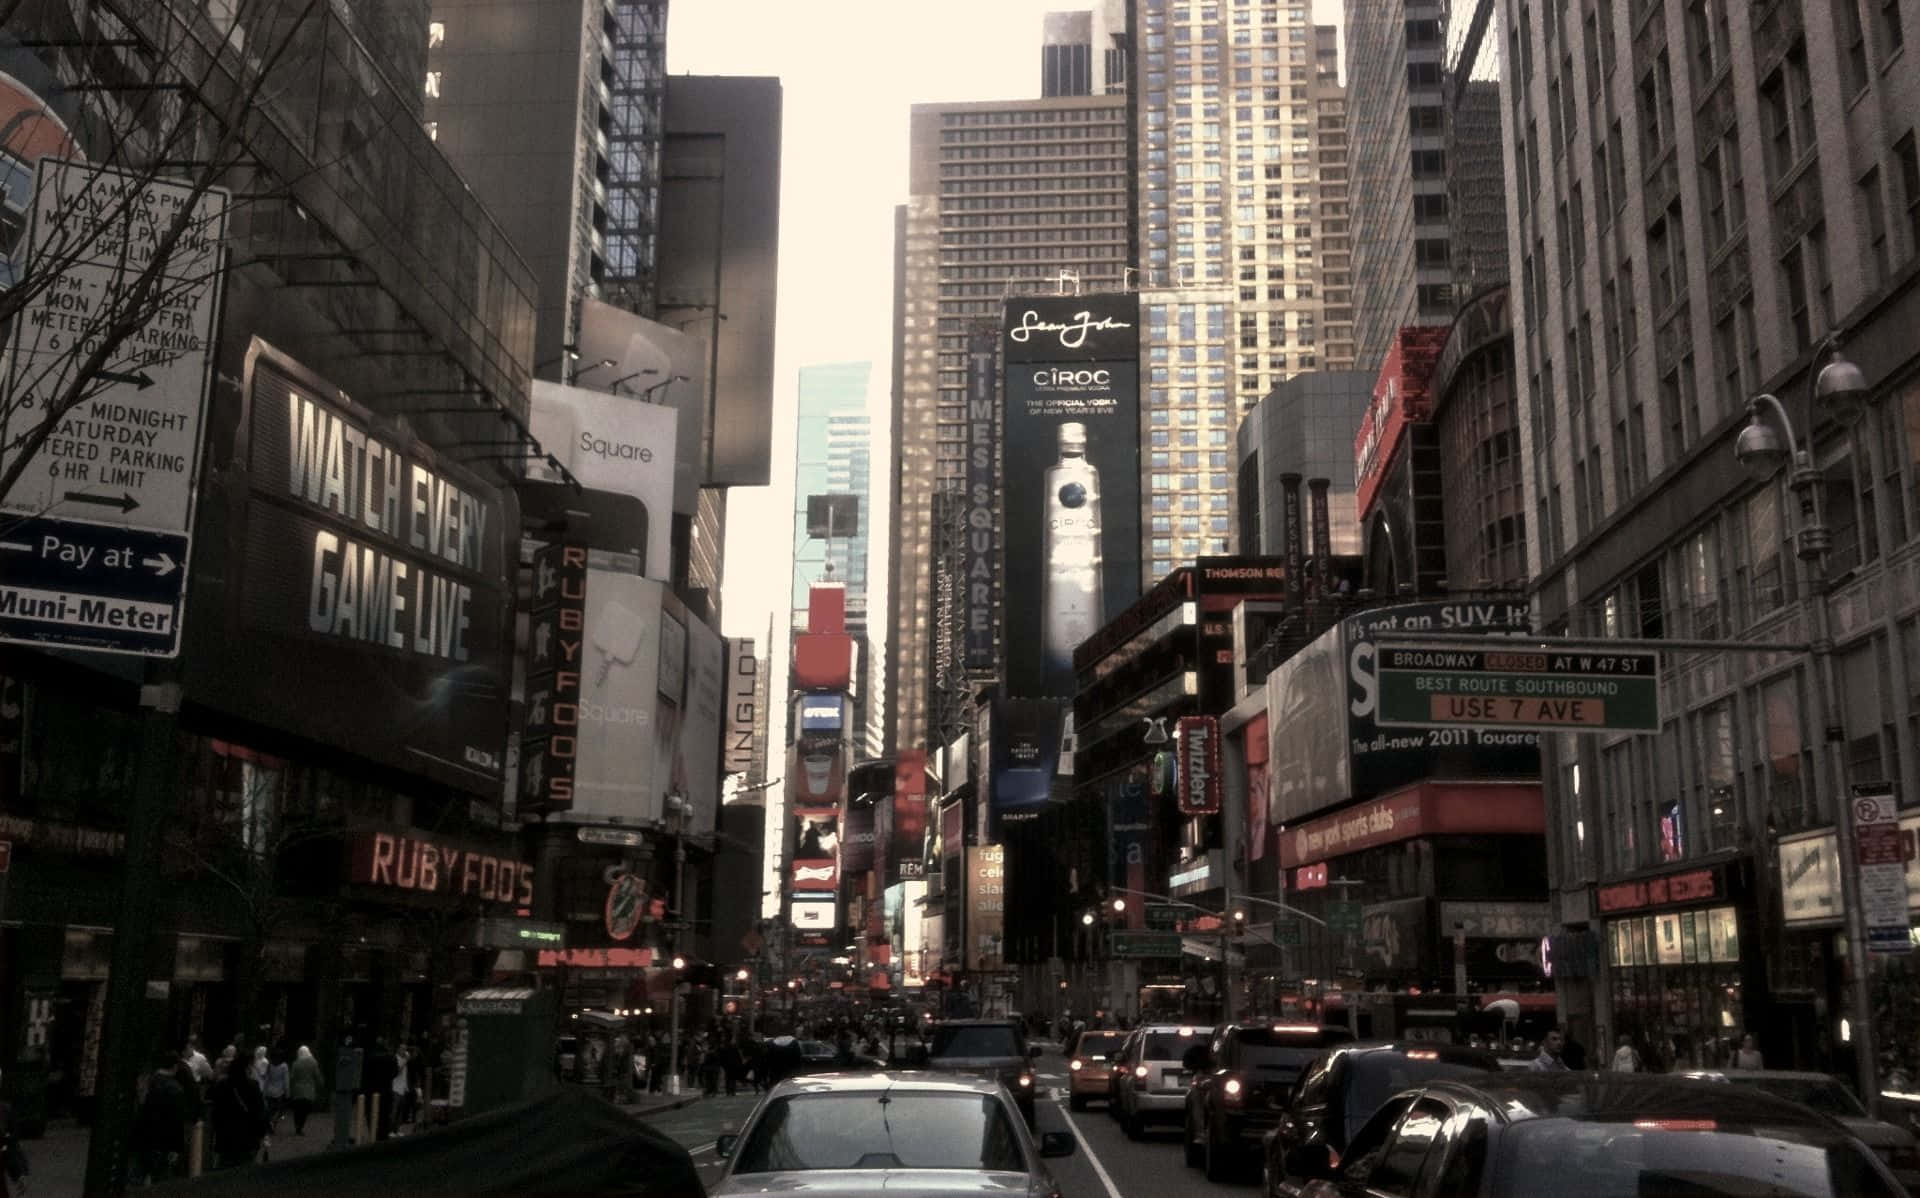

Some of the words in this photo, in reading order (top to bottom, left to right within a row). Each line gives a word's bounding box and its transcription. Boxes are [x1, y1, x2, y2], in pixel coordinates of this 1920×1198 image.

[161, 194, 185, 210] PM
[45, 209, 128, 239] MTERED
[50, 335, 60, 350] 6
[133, 327, 200, 352] ARKING
[91, 402, 188, 431] MIDNIGHT
[969, 354, 992, 468] TIMES
[14, 433, 99, 460] MTERED
[110, 447, 185, 473] PARKING
[580, 432, 654, 464] Square
[50, 462, 60, 477] 6
[65, 463, 89, 481] HR
[100, 467, 146, 488] LIMIT
[289, 391, 402, 539] WATCH
[410, 464, 487, 572] EVERY
[40, 536, 95, 569] Pay
[104, 547, 134, 568] at
[969, 483, 992, 631] SQUARE
[1205, 567, 1263, 578] THOMSON
[0, 590, 169, 630] Muni-Meter
[309, 530, 407, 649] GAME
[413, 569, 471, 661] LIVE
[1368, 616, 1397, 631] not
[1404, 615, 1432, 630] an
[1440, 605, 1497, 627] SUV.
[936, 607, 945, 688] AMERICAN
[1394, 653, 1477, 669] BROADWAY
[1486, 654, 1546, 670] CLOSED
[1554, 656, 1573, 670] AT
[1579, 657, 1592, 671] W
[1597, 657, 1617, 671] 47
[1621, 658, 1640, 672] ST
[733, 638, 756, 762] INGLOT
[1415, 677, 1452, 690] BEST
[1459, 678, 1508, 693] ROUTE
[1515, 680, 1619, 695] SOUTHBOUND
[1451, 699, 1496, 718] USE
[1510, 700, 1522, 719] 7
[1538, 701, 1584, 720] AVE
[1371, 734, 1424, 751] all-new
[1429, 730, 1469, 746] 2011
[370, 832, 458, 892] RUBY
